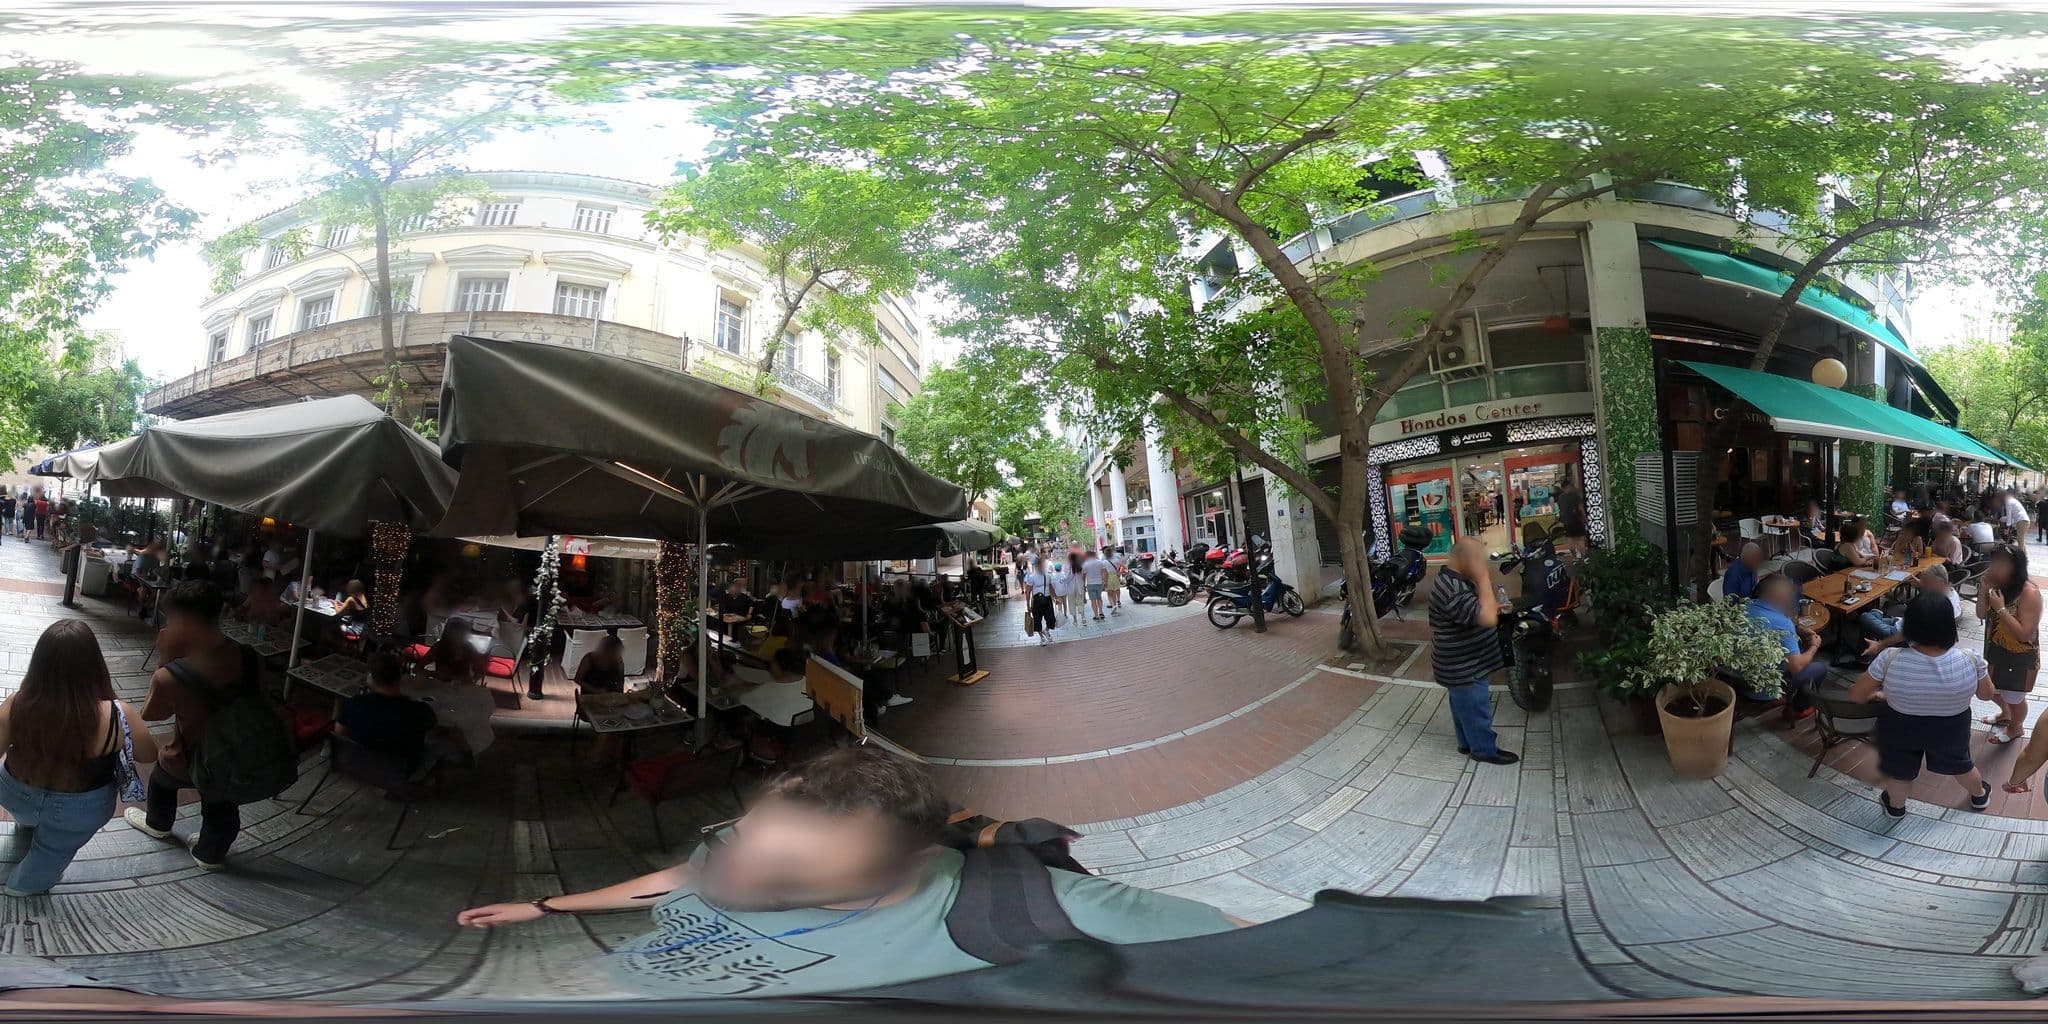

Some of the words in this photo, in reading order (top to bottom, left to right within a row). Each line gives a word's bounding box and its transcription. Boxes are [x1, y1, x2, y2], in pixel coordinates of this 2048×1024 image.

[1400, 412, 1467, 434] Hondos
[1475, 402, 1543, 421] Center
[1462, 431, 1493, 441] APIVITA
